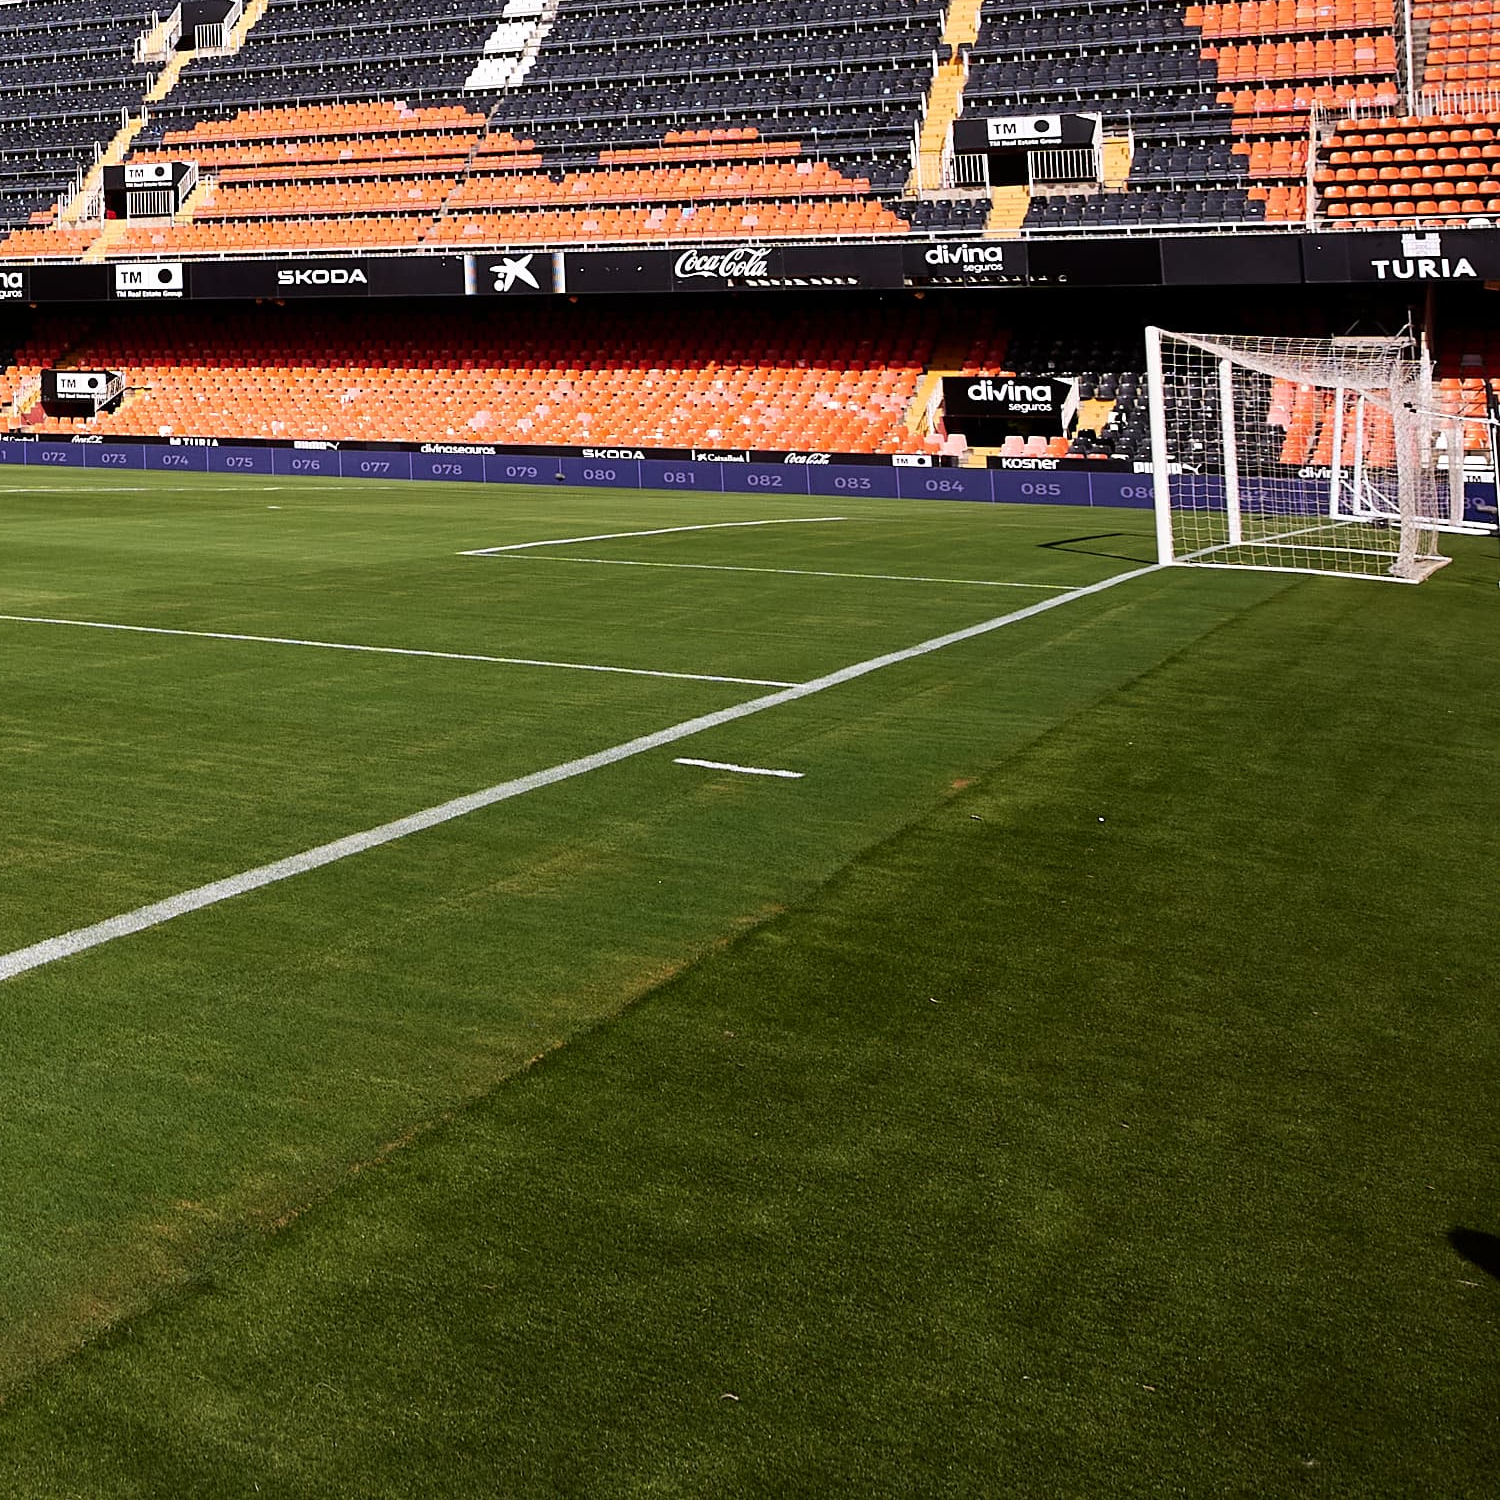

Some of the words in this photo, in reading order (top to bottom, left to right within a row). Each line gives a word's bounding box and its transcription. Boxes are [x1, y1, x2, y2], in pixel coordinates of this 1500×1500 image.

[993, 122, 1016, 134] TM
[1001, 137, 1016, 145] Real
[1017, 137, 1038, 145] Estate
[1040, 137, 1062, 146] Group
[129, 169, 144, 177] TM
[925, 244, 1003, 265] divina
[674, 248, 772, 278] Coca-Cola
[963, 263, 1003, 274] seguros
[1371, 259, 1477, 279] TURIA
[121, 271, 142, 283] TM
[61, 379, 76, 388] TM
[967, 379, 1052, 402] divina
[1008, 400, 1052, 413] seguros
[42, 452, 67, 462] 072
[101, 454, 126, 464] 073
[163, 455, 188, 465] 074
[226, 457, 253, 467] 075
[292, 459, 320, 470] 076
[361, 461, 390, 472] 077
[432, 464, 462, 475] 078
[1001, 457, 1060, 470] kosner
[506, 466, 537, 477] 079
[584, 469, 616, 480] 080
[664, 471, 695, 483] 081
[1298, 466, 1349, 479] divia
[747, 474, 782, 486] 082
[834, 477, 871, 489] 083
[926, 479, 964, 492] 084
[1021, 483, 1061, 496] 085
